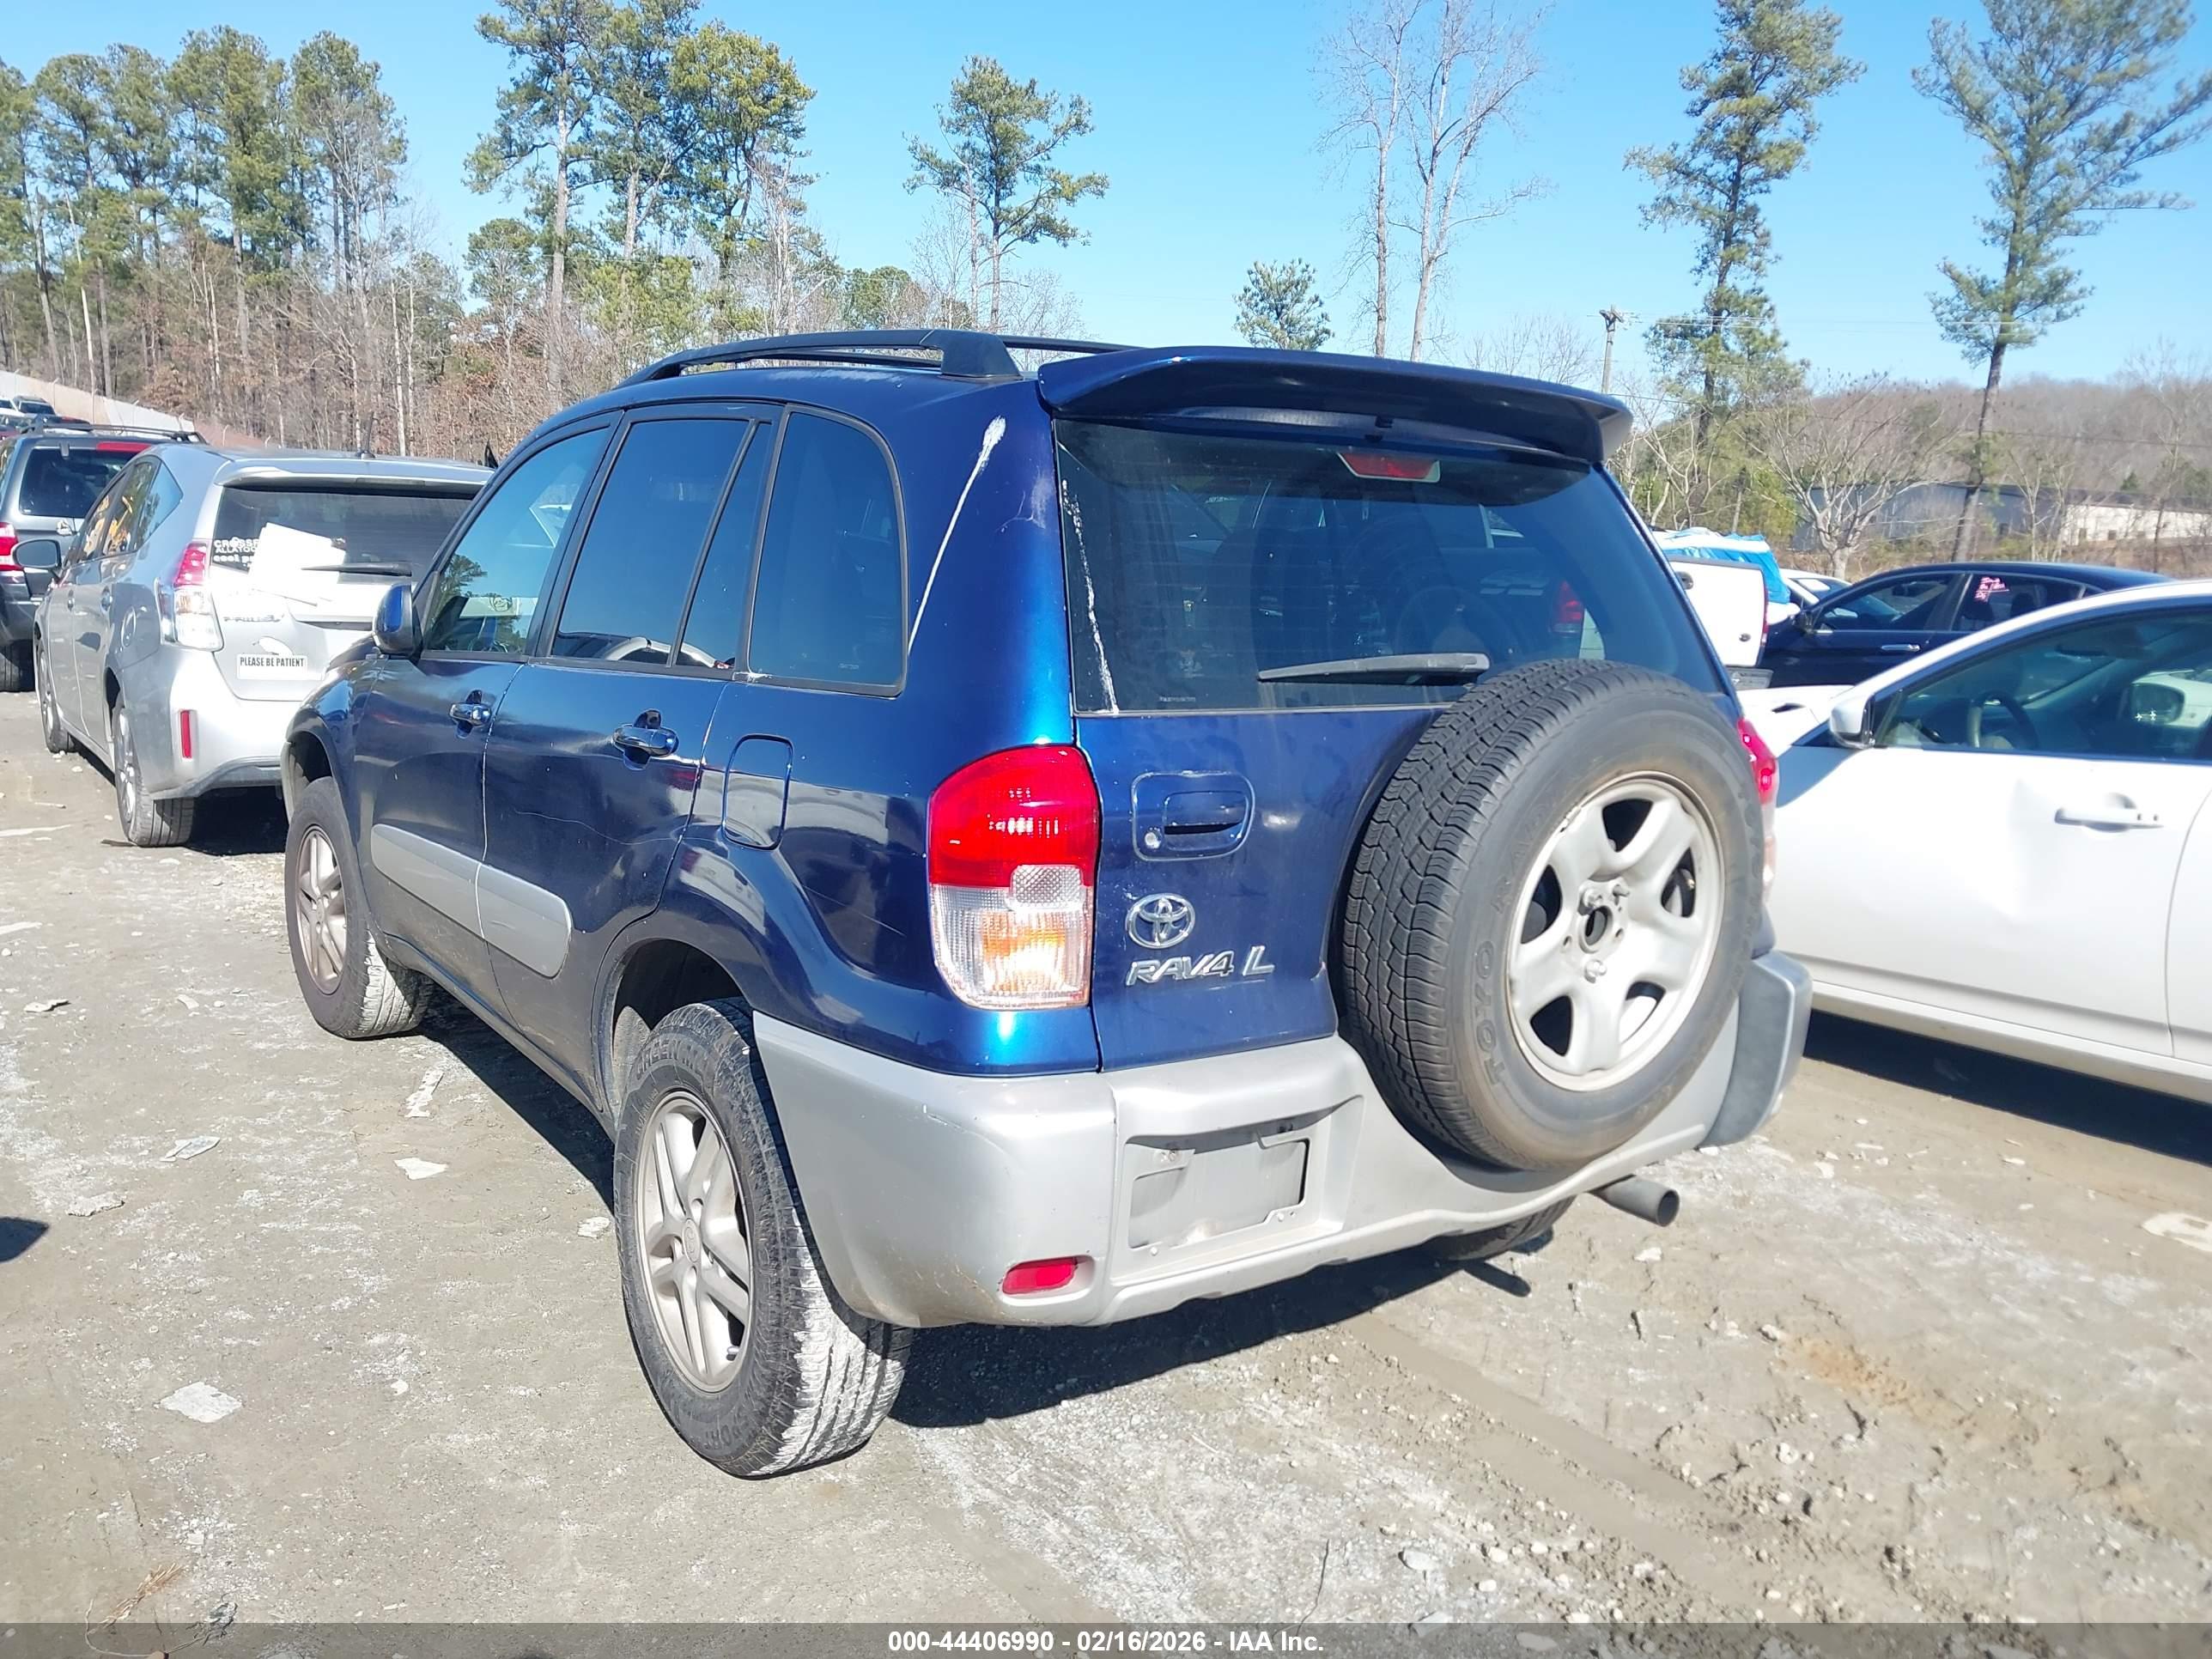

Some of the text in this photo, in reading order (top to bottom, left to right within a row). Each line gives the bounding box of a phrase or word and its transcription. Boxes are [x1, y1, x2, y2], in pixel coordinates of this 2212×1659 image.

[240, 657, 305, 667] PLEASE BE PATIENT
[1126, 945, 1275, 986] RAV4 L
[1474, 940, 1506, 1085] TOYO
